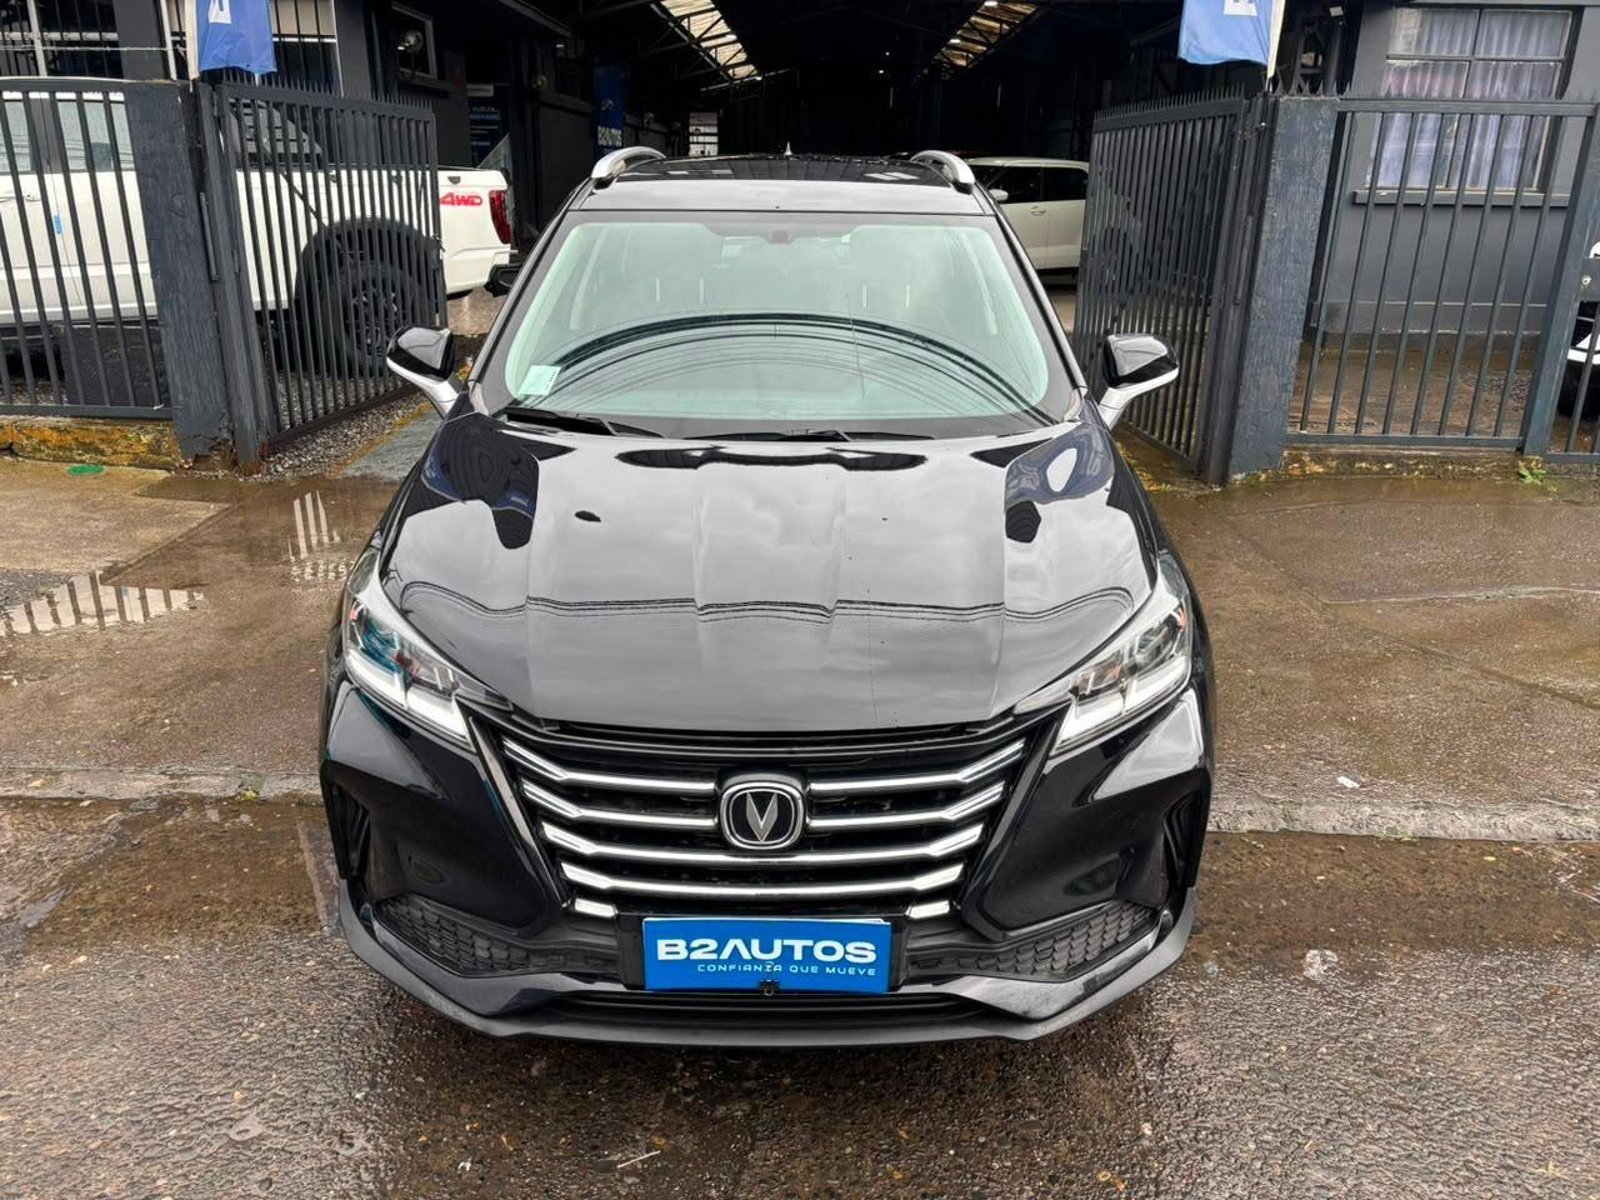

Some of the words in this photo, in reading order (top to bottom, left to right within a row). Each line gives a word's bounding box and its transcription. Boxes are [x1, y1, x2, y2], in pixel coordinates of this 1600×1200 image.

[440, 192, 483, 206] 4WD
[656, 938, 877, 963] B2AUTOS
[697, 963, 783, 973] CONFIANZA
[789, 964, 819, 973] QUE
[825, 966, 876, 976] MUEVE
